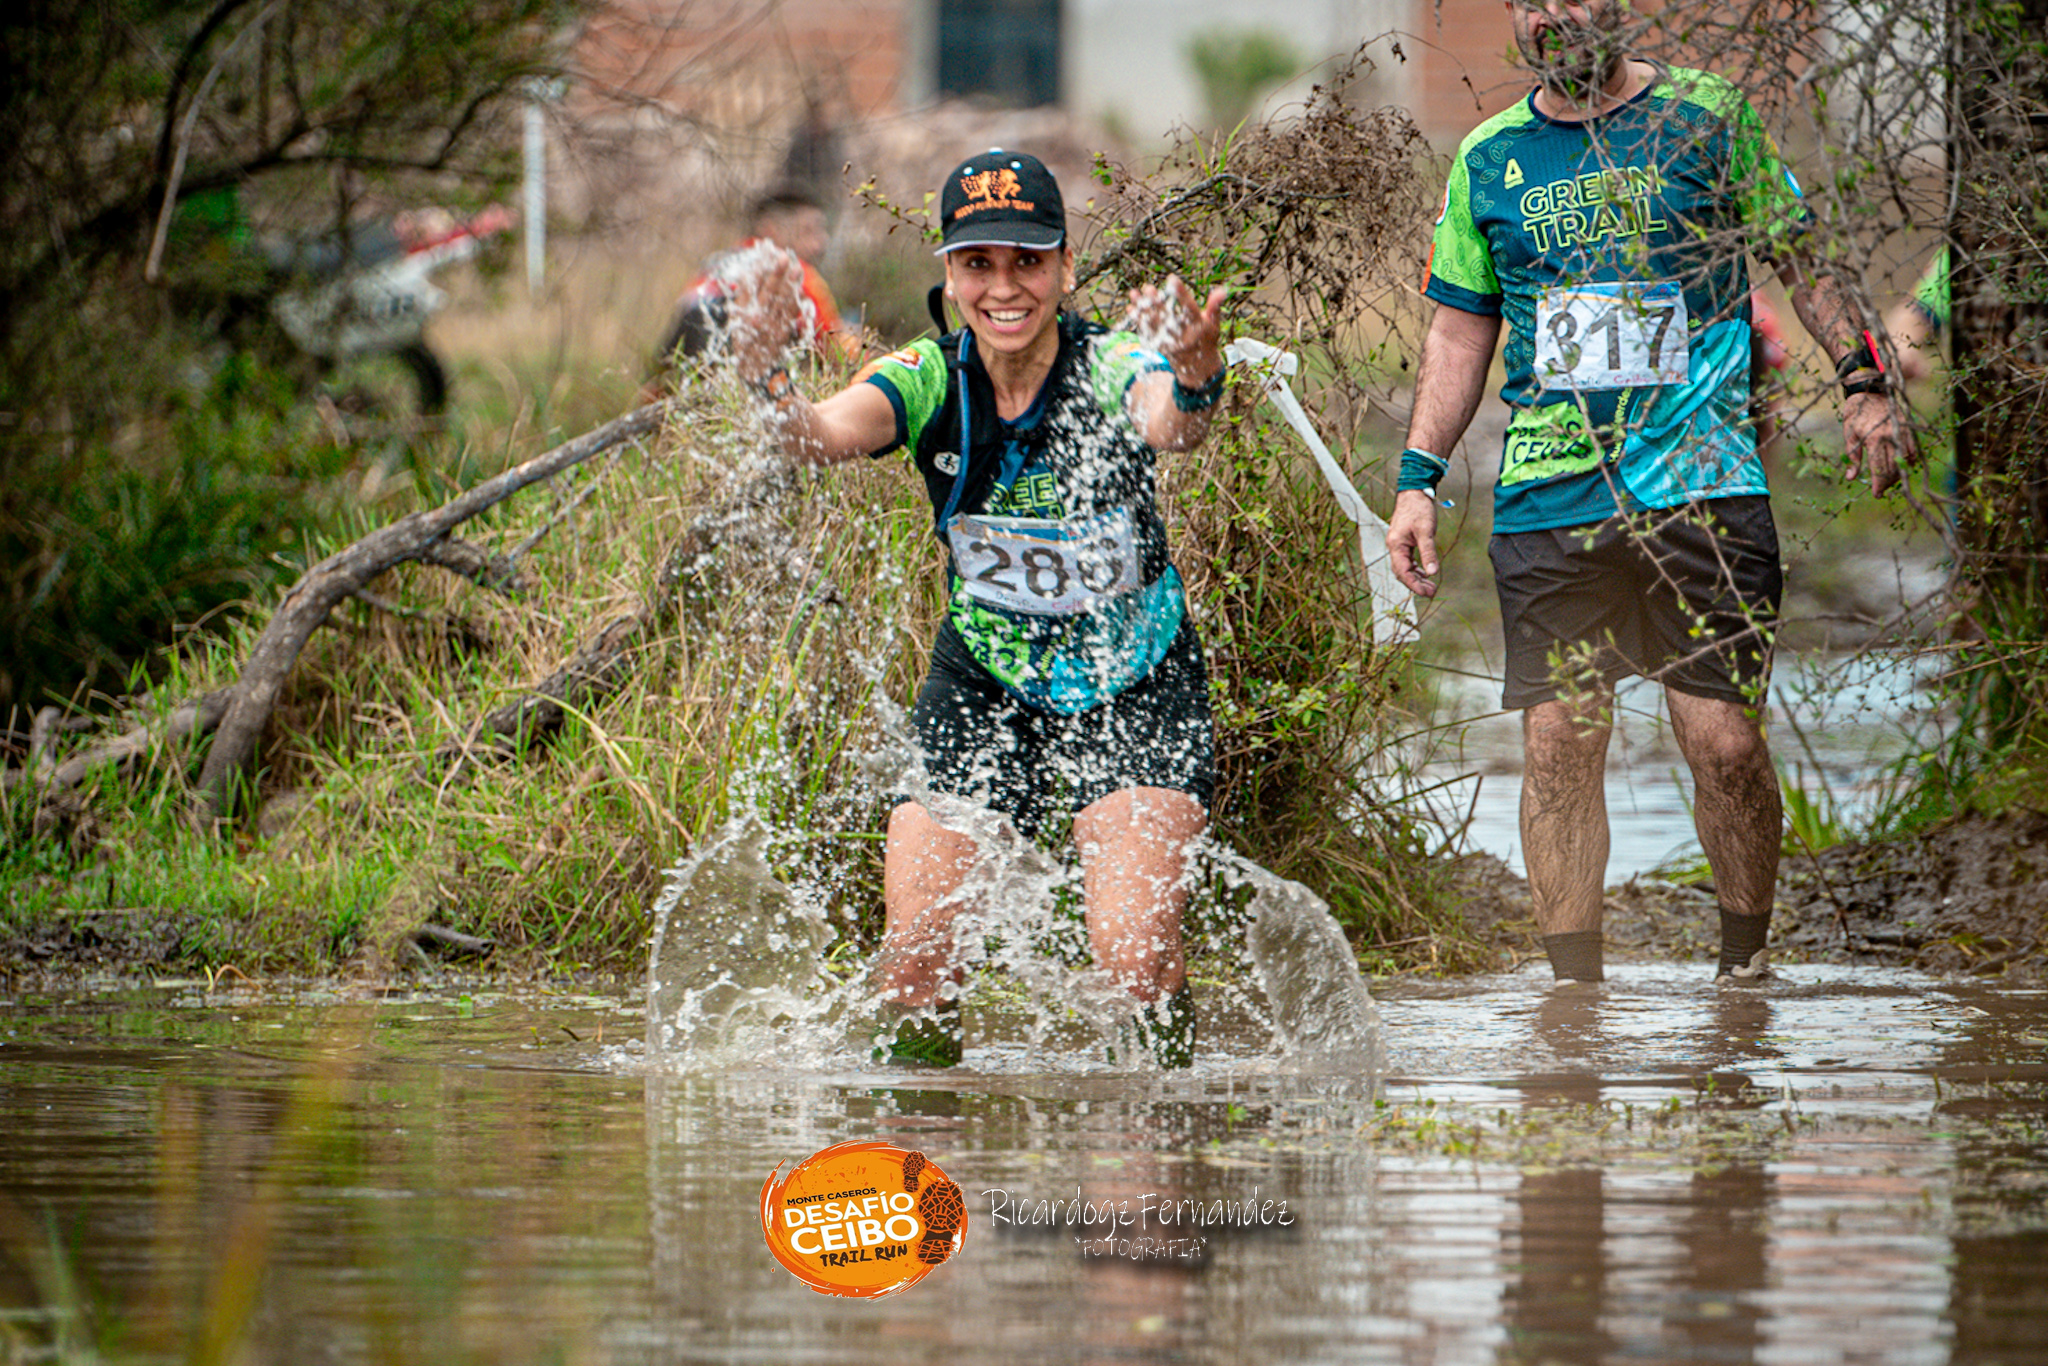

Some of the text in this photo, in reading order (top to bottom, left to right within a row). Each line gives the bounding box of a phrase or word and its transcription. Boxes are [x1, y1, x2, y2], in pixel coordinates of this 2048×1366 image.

[1519, 164, 1662, 218] GREEN
[1522, 197, 1668, 253] TRAIL
[1546, 305, 1675, 374] 317
